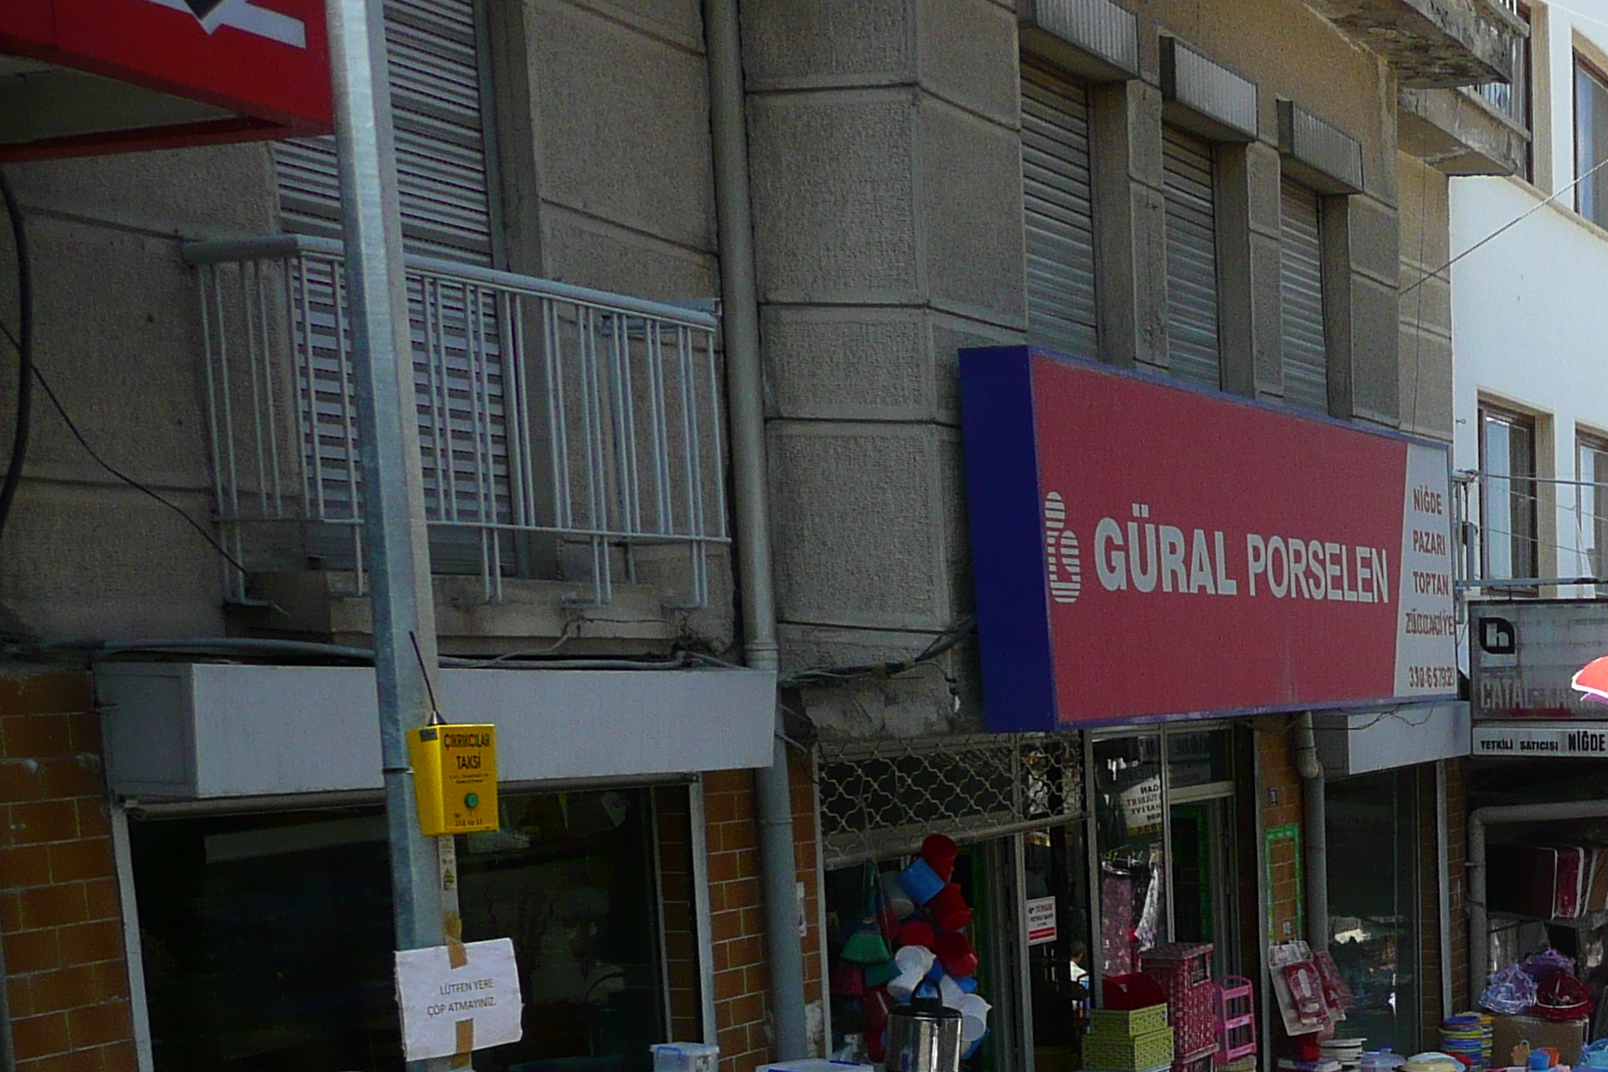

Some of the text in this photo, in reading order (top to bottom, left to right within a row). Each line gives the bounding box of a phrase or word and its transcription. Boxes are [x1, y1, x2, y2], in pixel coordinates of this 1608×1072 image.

[1094, 504, 1389, 604] GÜRAL PORSELEN
[1413, 529, 1446, 556] PAZARI
[1413, 571, 1449, 596] TOPTAN
[1568, 731, 1605, 752] NİĞDE
[456, 751, 481, 770] TAKSİ
